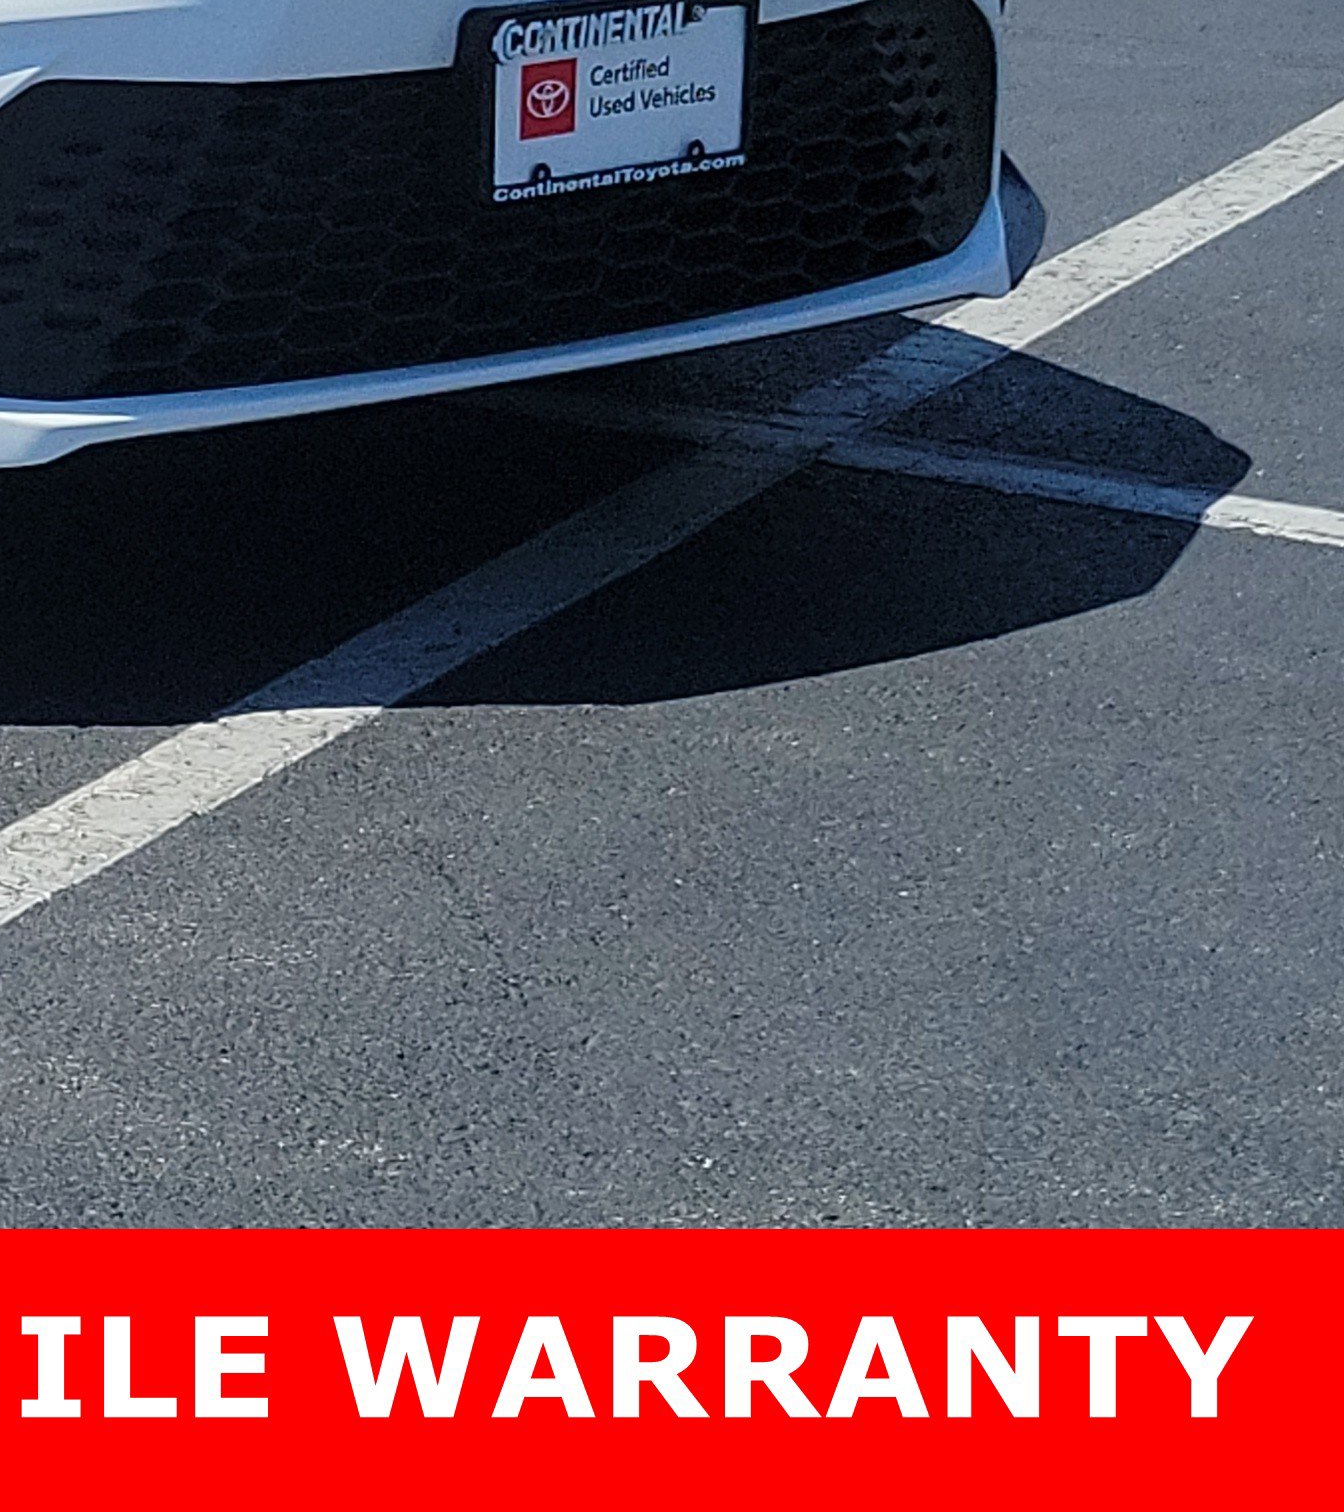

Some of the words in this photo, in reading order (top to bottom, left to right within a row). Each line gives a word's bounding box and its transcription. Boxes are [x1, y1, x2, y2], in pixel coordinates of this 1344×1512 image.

[493, 1, 689, 62] CONTINENTAL
[590, 55, 670, 86] Certified
[590, 89, 635, 118] Used
[640, 82, 716, 111] Vehicles
[492, 153, 746, 203] ContinentalToyota.com
